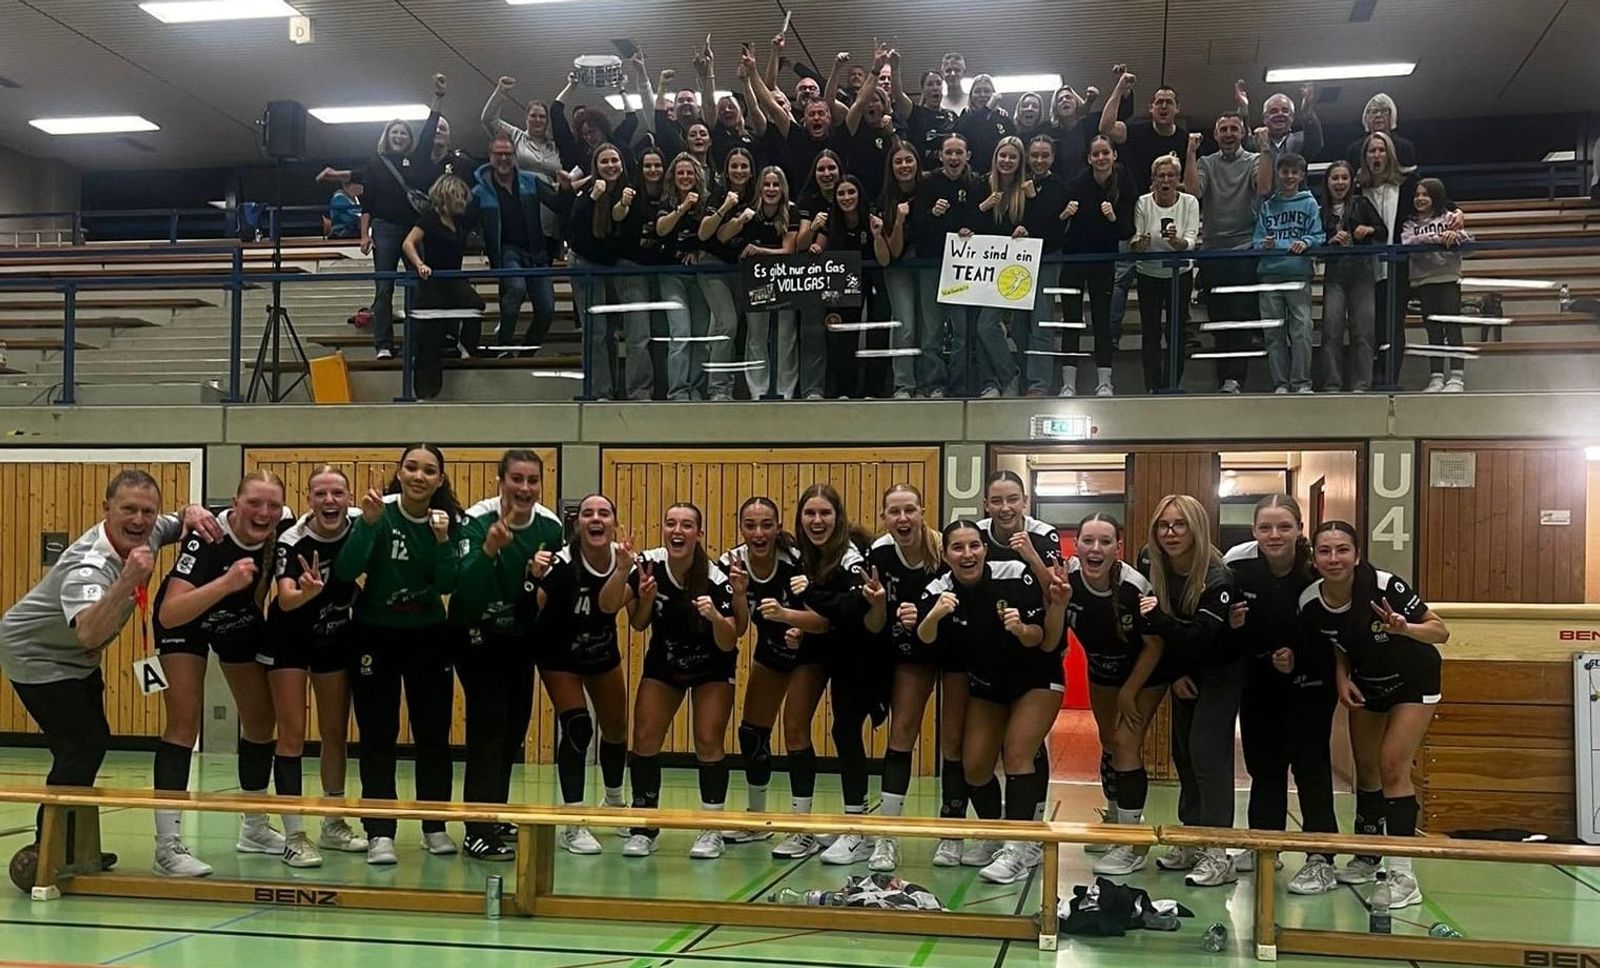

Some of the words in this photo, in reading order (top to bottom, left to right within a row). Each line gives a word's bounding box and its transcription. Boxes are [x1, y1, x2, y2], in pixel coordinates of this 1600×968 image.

[296, 26, 304, 38] D
[1265, 210, 1309, 229] SYDNEY
[951, 239, 976, 259] Wir
[983, 244, 1009, 260] sind
[1016, 250, 1032, 262] ein
[754, 263, 767, 278] Es
[770, 263, 787, 282] gibt
[789, 266, 805, 276] nur
[825, 260, 845, 274] Gas
[952, 264, 995, 282] TEAM
[391, 540, 409, 561] 12
[574, 596, 591, 615] 14
[143, 663, 166, 693] A
[254, 887, 339, 907] BENZ
